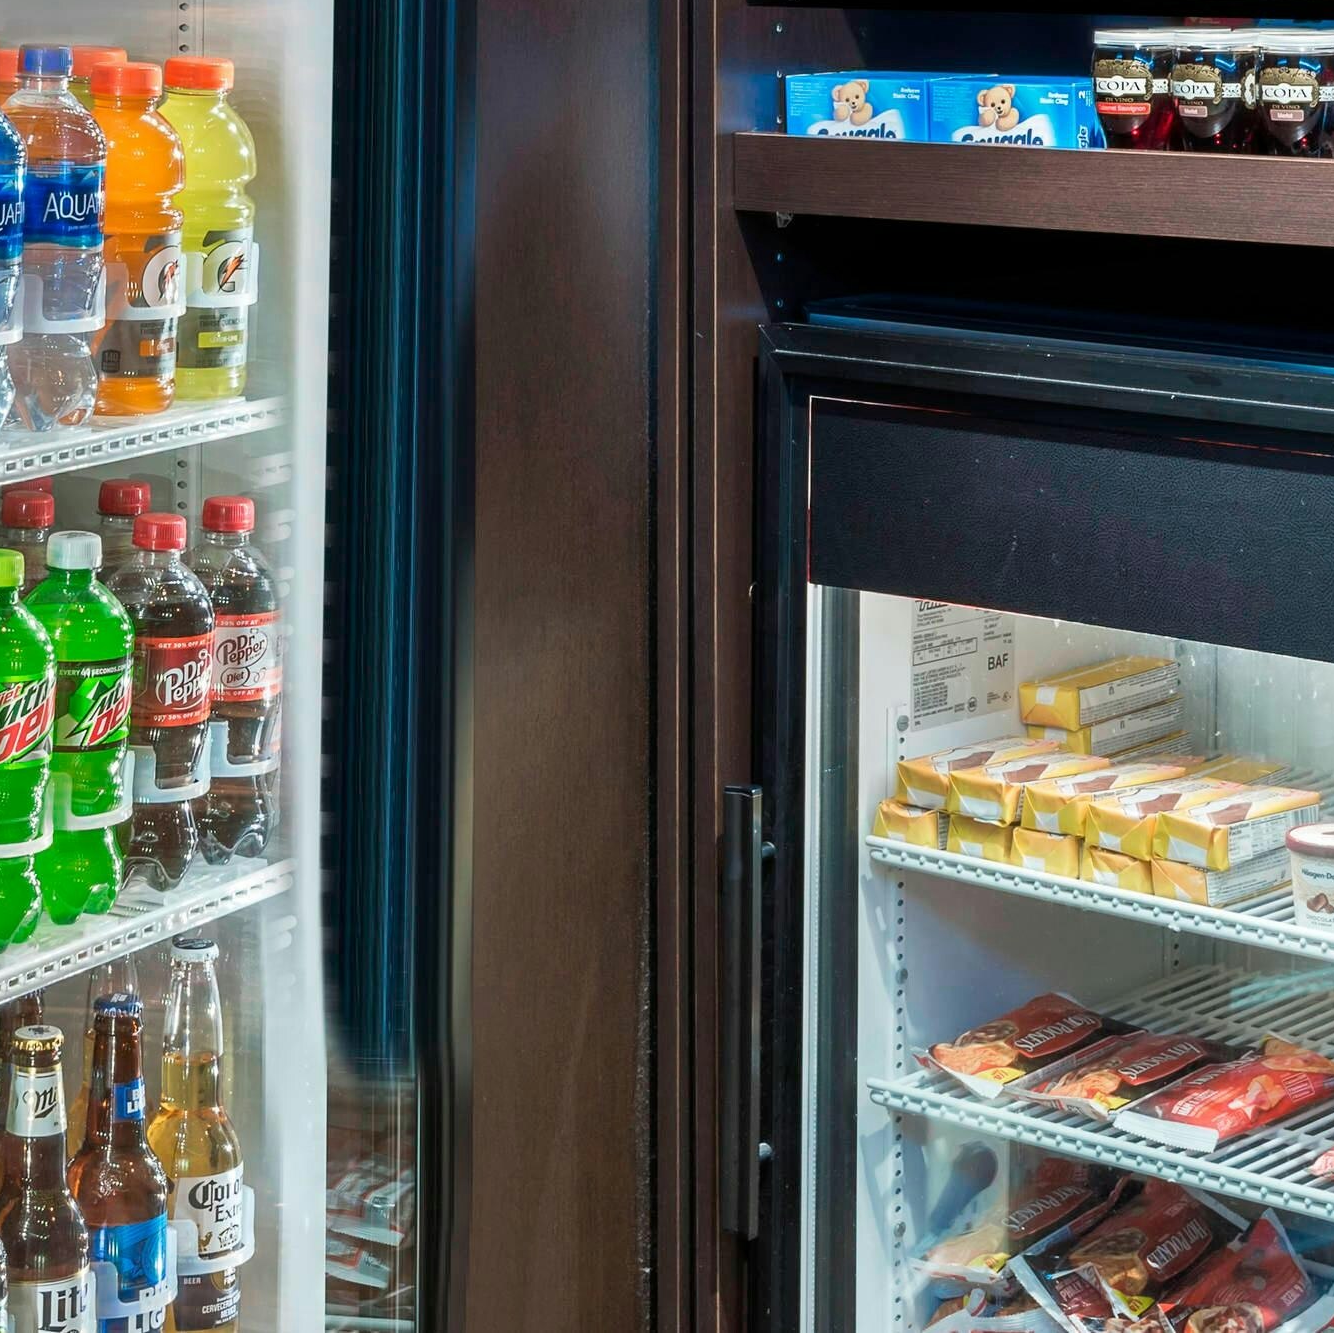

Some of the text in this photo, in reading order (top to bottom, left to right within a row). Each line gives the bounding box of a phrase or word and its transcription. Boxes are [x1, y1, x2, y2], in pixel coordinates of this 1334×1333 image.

[1097, 81, 1141, 92] COPA
[1174, 83, 1210, 94] COPA
[1264, 87, 1307, 98] COPA
[42, 192, 103, 224] AQUA
[217, 638, 265, 666] Pepper
[237, 634, 256, 653] Dr
[182, 658, 206, 683] Dr
[987, 653, 1009, 671] BAF
[164, 667, 212, 707] Pepp
[226, 671, 245, 684] Diet
[1014, 1018, 1071, 1053] POCKETS
[188, 1179, 243, 1211] Coro
[1185, 1218, 1209, 1246] HOT
[183, 1277, 202, 1285] BEER
